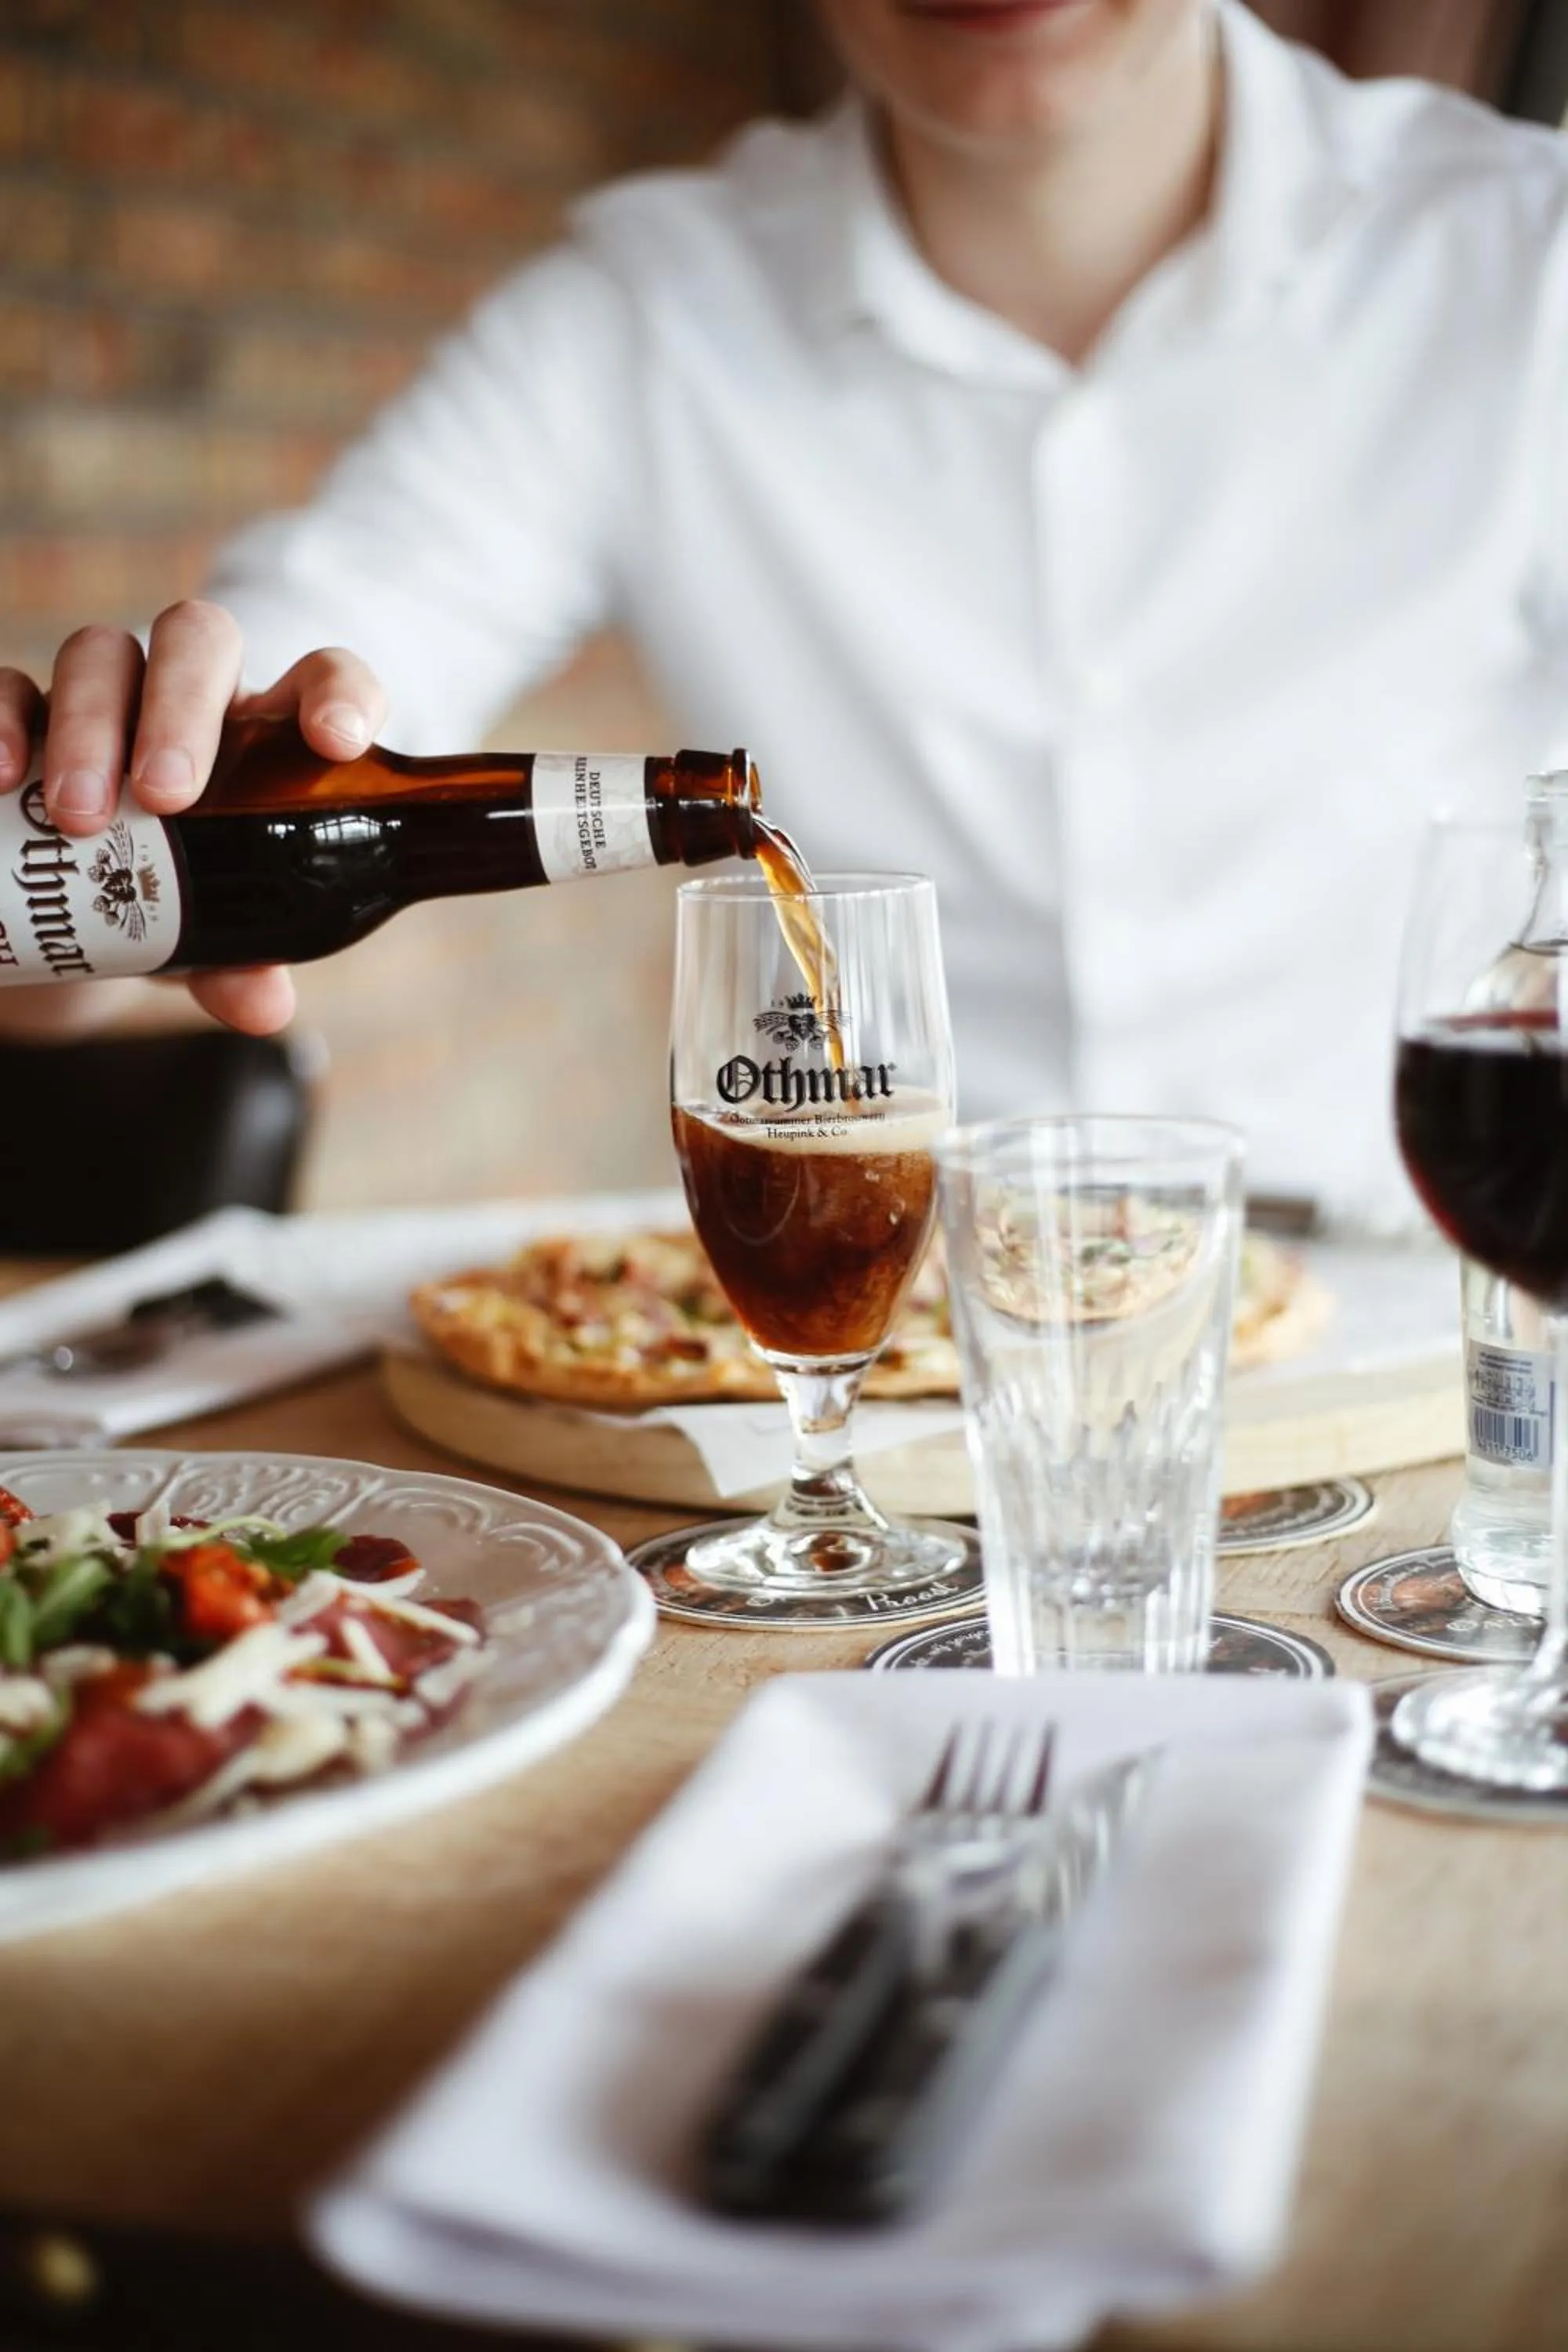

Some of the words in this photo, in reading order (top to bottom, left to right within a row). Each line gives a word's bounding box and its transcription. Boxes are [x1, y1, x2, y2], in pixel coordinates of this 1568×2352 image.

[589, 771, 606, 849] DEUTSCHE
[717, 1054, 895, 1112] Othmar
[766, 1127, 815, 1142] Heupink
[817, 1127, 827, 1138] &
[858, 1581, 959, 1611] Proost
